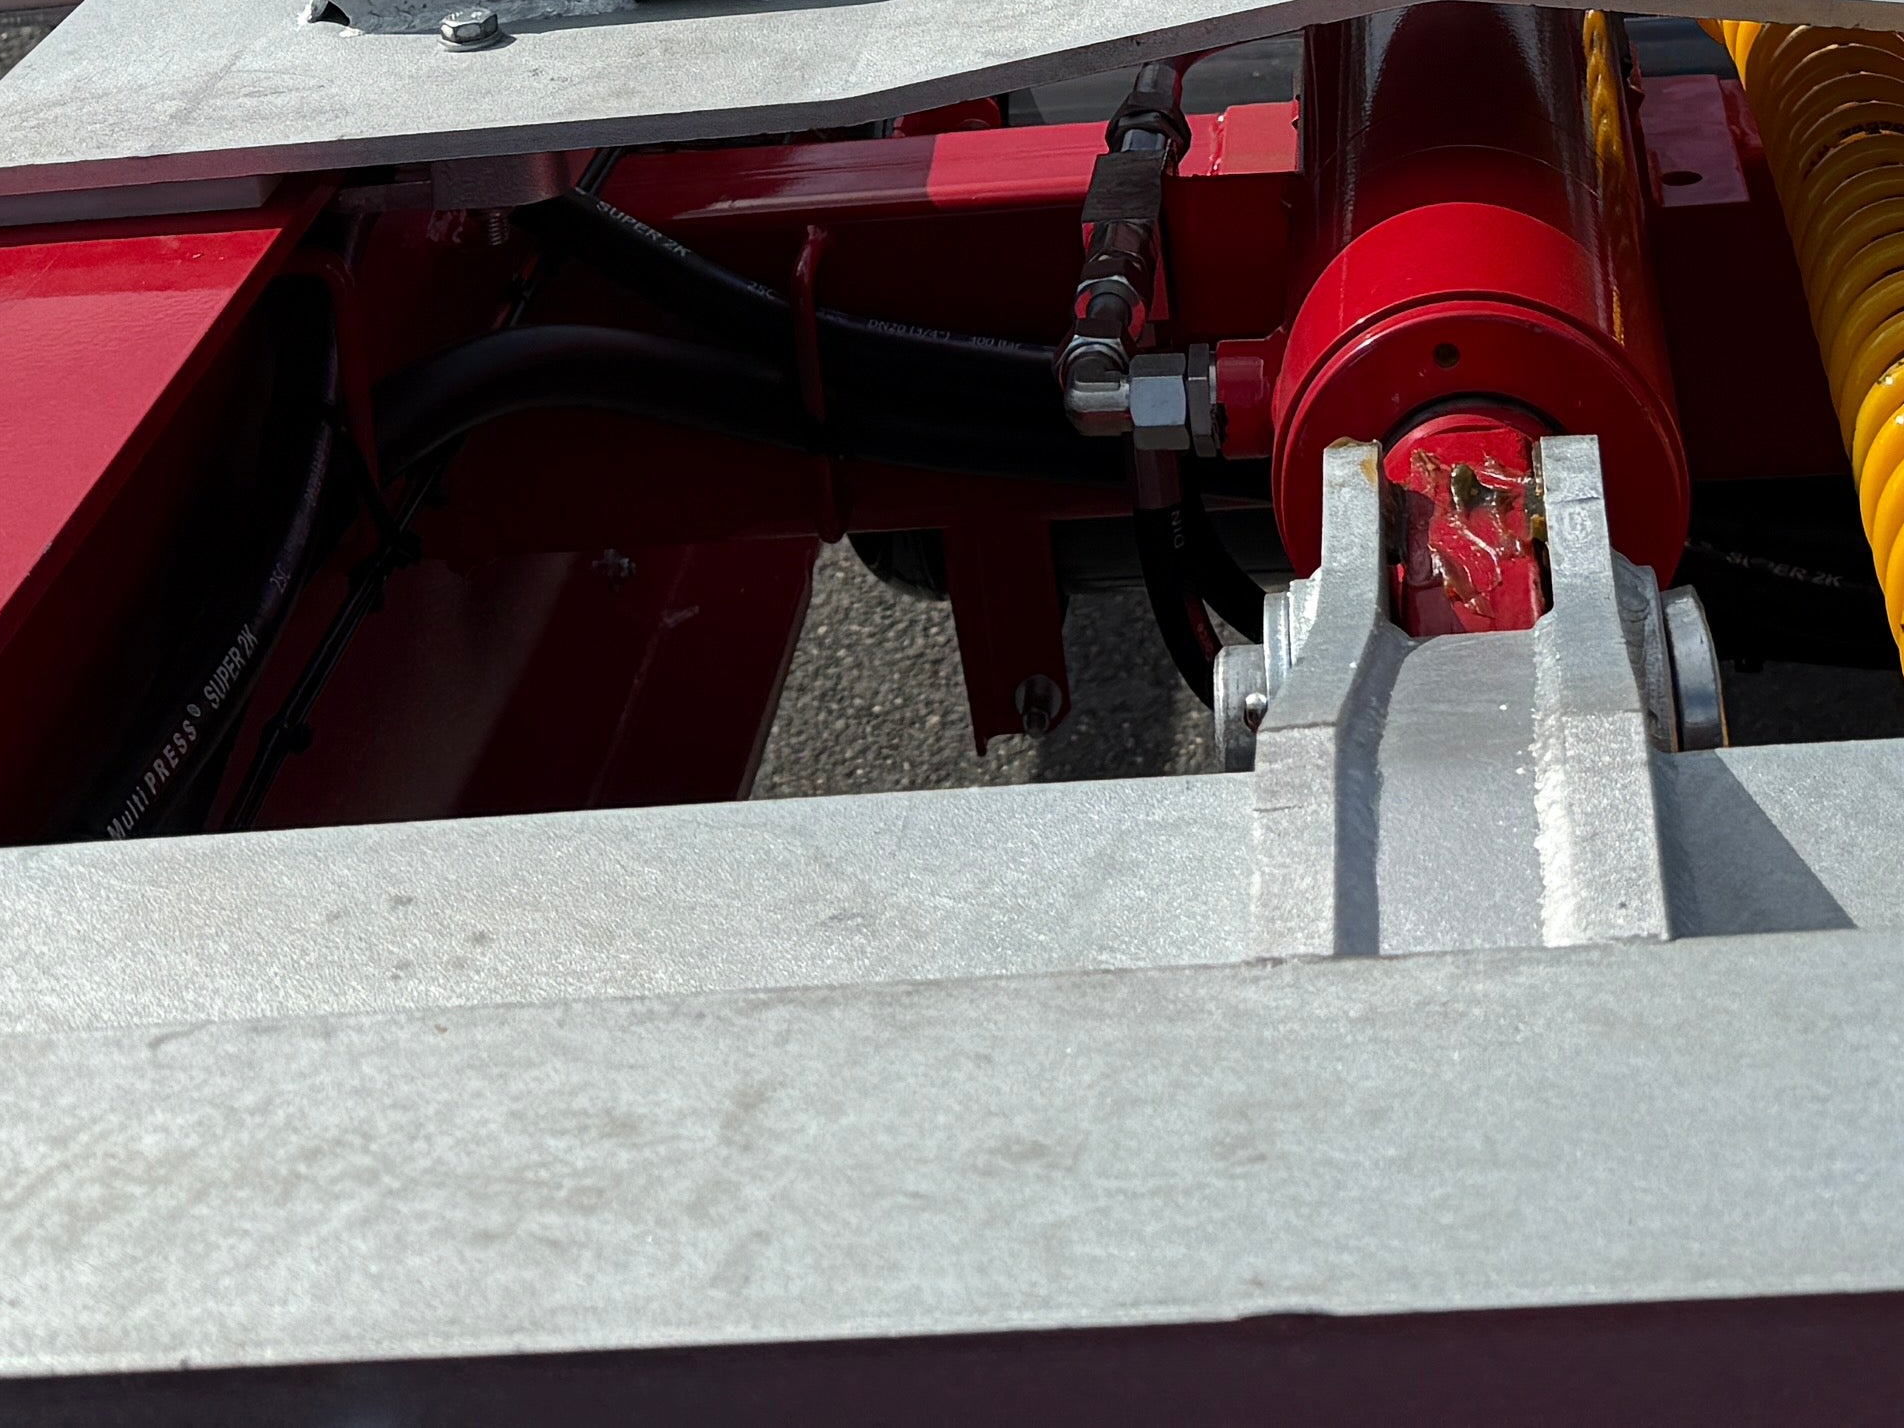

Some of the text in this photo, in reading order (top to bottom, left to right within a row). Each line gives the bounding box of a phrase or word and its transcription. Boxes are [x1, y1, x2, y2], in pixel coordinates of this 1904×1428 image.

[596, 199, 662, 242] SUPER
[1725, 551, 1808, 582] SUER
[203, 645, 247, 710] SUPER
[237, 623, 259, 659] 2K
